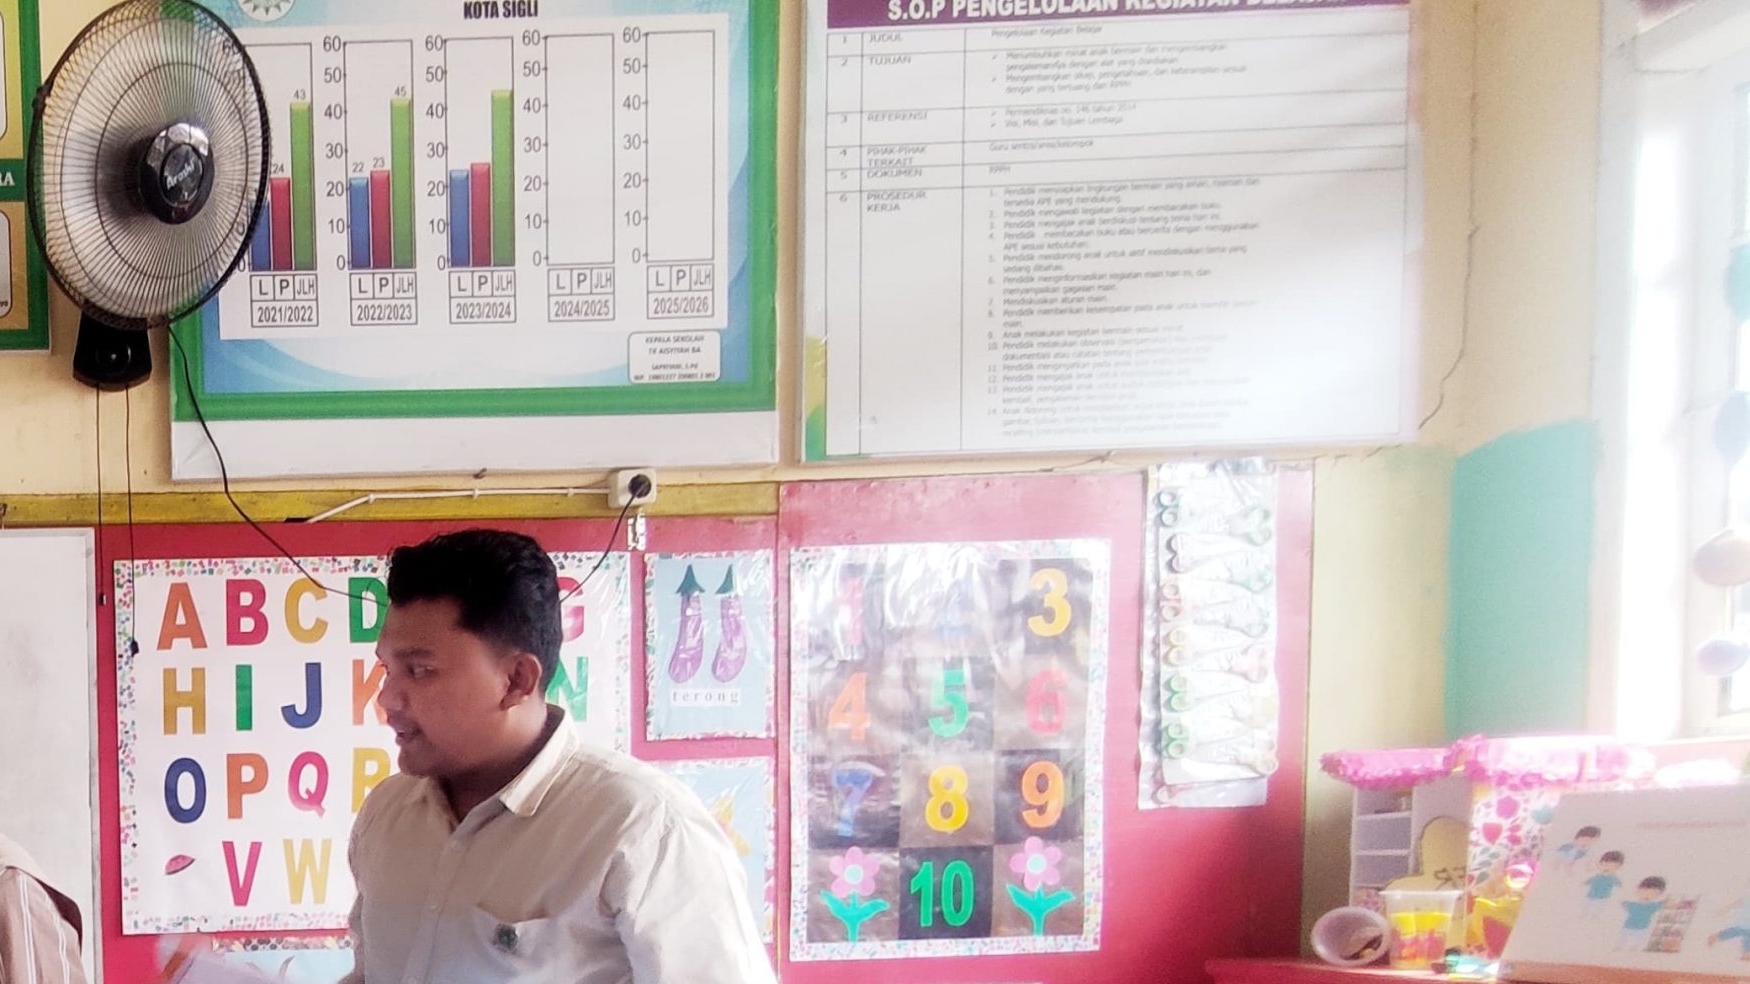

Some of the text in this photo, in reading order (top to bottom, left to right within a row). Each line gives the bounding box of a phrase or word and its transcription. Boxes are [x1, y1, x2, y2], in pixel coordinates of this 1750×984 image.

[463, 0, 538, 20] KOTA SIGLI
[293, 89, 306, 99] 43
[394, 87, 407, 97] 45
[352, 162, 365, 173] 22
[372, 158, 385, 168] 23
[257, 306, 313, 323] 2021/2022
[357, 304, 412, 321] 2022/2023
[456, 302, 512, 320] 2023/2024
[554, 300, 610, 317] 2024/2025
[653, 297, 709, 314] 2025/2026
[1028, 568, 1072, 637] 3
[156, 576, 389, 650] A B C D
[162, 662, 322, 735] H I J
[673, 691, 738, 704] terong
[828, 668, 1066, 740] 4 5 6
[164, 751, 329, 824] O P Q
[925, 760, 1066, 832] 8 9
[222, 838, 332, 907] V W
[910, 860, 974, 927] 10
